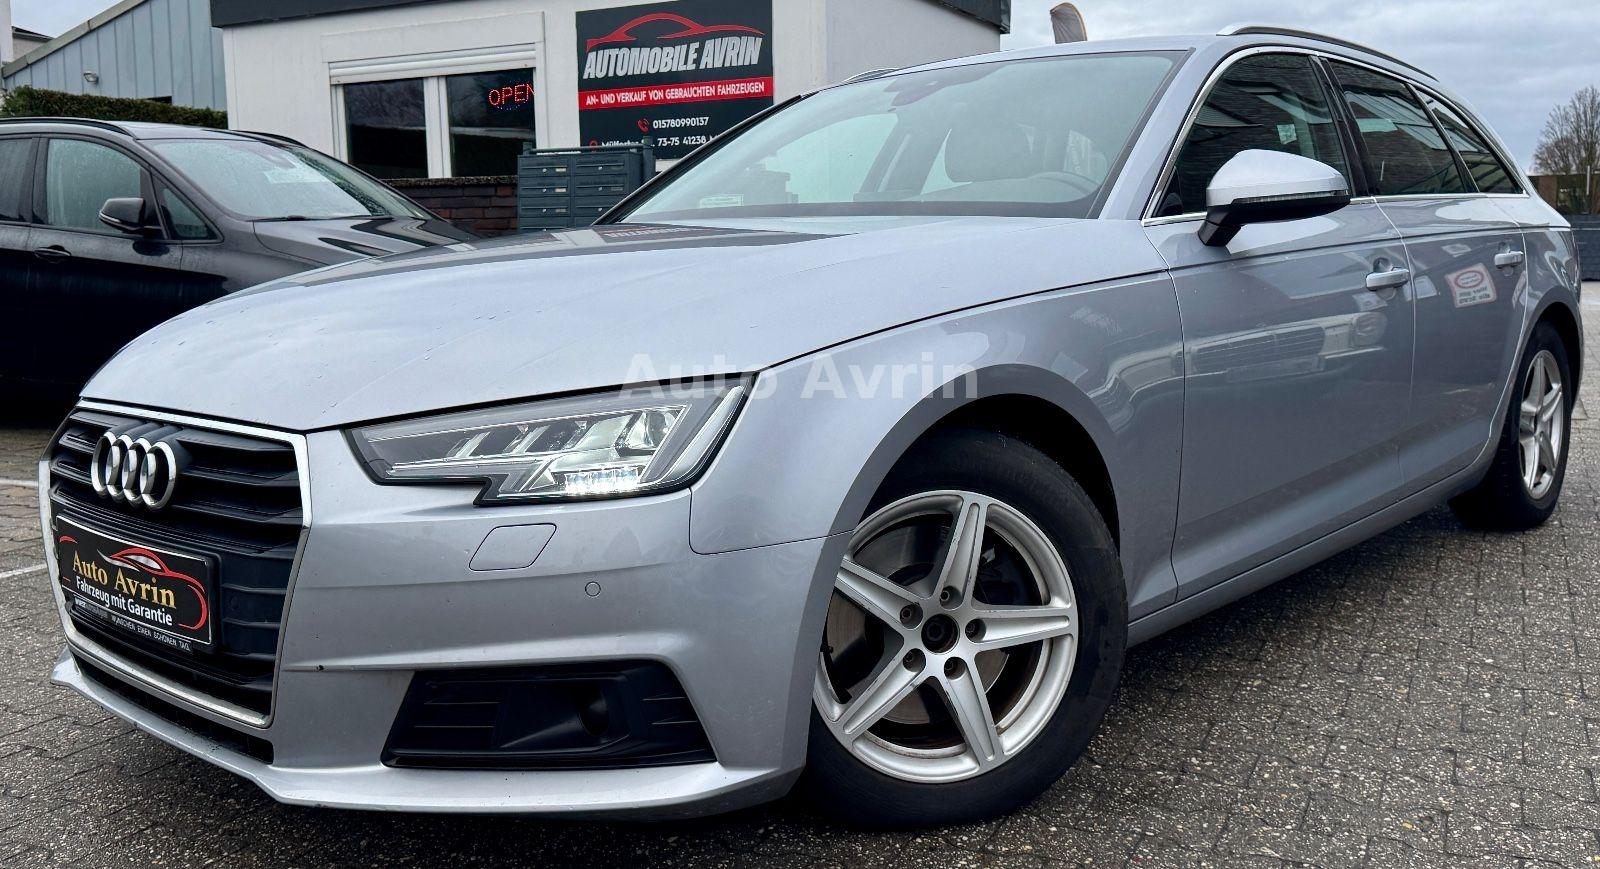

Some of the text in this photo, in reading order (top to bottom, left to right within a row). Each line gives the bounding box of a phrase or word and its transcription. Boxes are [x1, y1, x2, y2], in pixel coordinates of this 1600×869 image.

[583, 36, 762, 79] AUTOMOBILE AVRIN
[488, 83, 536, 106] OPEN
[586, 82, 765, 106] AN- UND VERKAUF VON GEBRAUCHTEN FAHRZEUGEN
[653, 117, 709, 129] 015780990137
[657, 138, 680, 147] 73-75
[683, 136, 706, 145] 41238
[72, 550, 108, 586] Auto
[114, 568, 176, 610] Avrin
[76, 576, 110, 607] Fahrzeug
[111, 595, 126, 611] mit
[127, 599, 173, 626] Garantie
